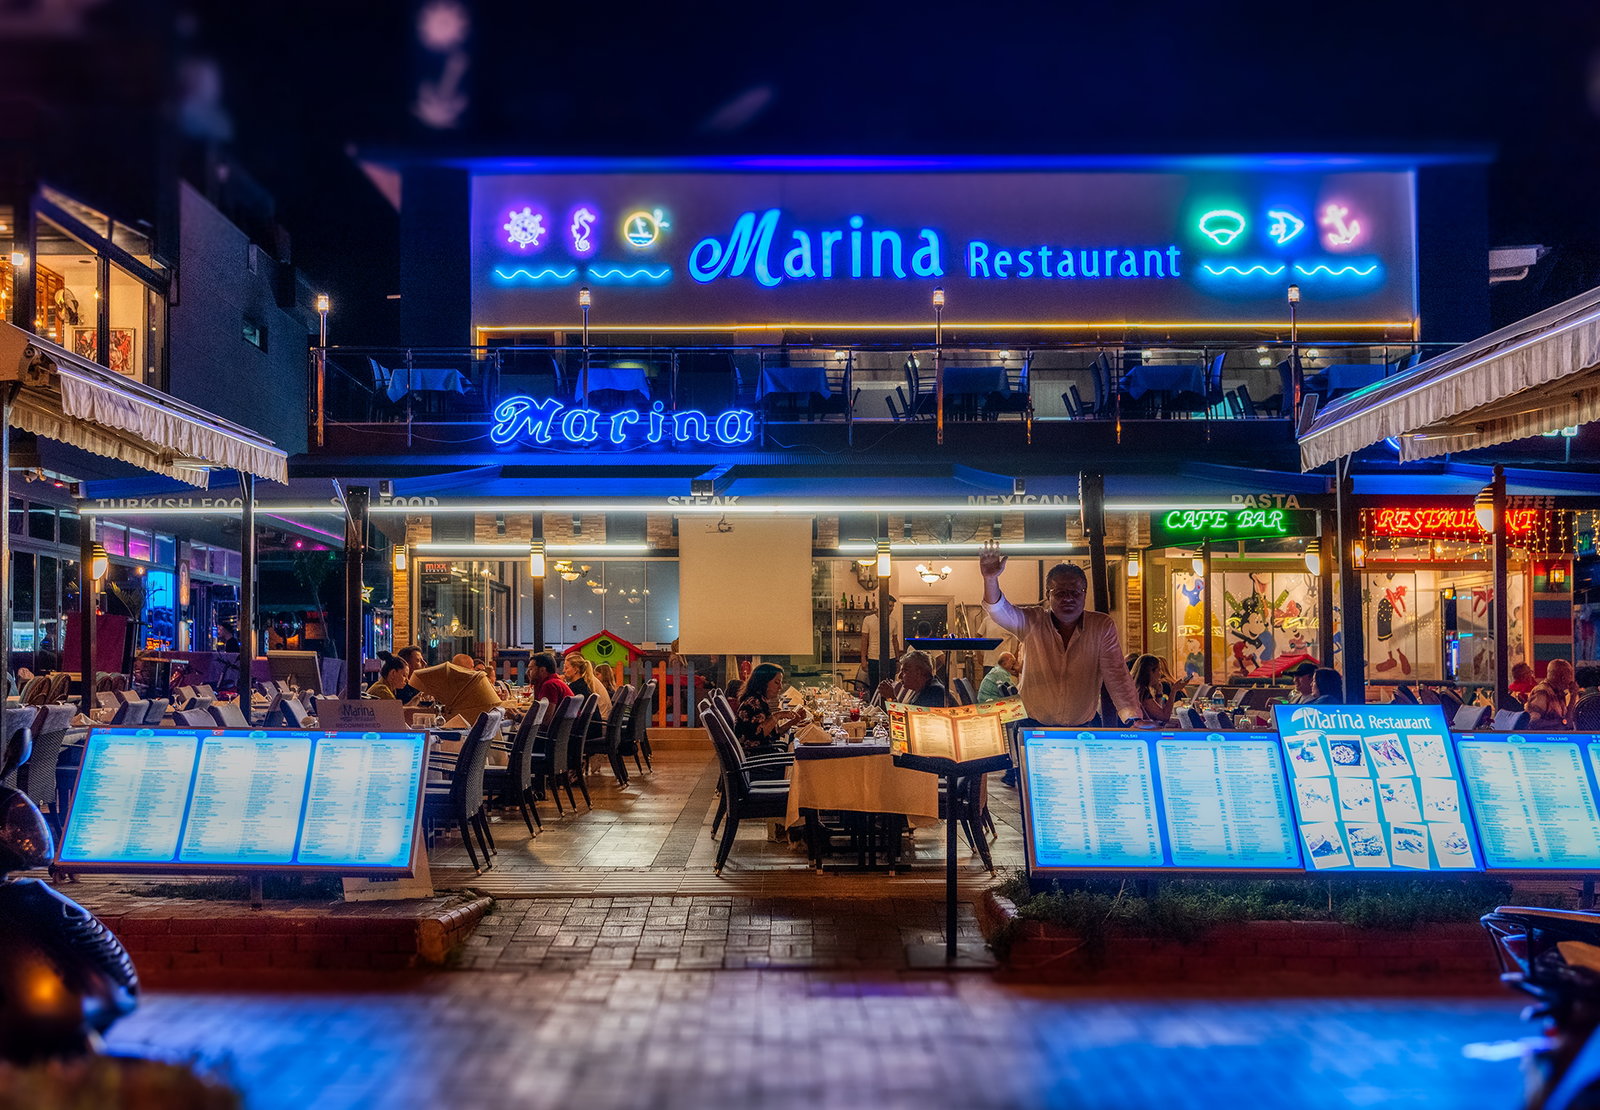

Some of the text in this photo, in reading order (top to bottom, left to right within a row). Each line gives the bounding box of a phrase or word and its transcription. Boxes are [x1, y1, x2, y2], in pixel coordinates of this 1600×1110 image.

[688, 208, 1182, 287] Marina Restaurant
[490, 396, 754, 444] Marina
[96, 498, 193, 509] TURKISH
[380, 496, 439, 507] FOOD
[667, 495, 740, 506] STEAK
[967, 494, 1068, 505] MEXICAN
[1231, 494, 1300, 509] PASTA
[1166, 510, 1287, 532] CAFE BAR
[343, 703, 375, 717] Marina
[1302, 708, 1432, 730] Marina Restaurant
